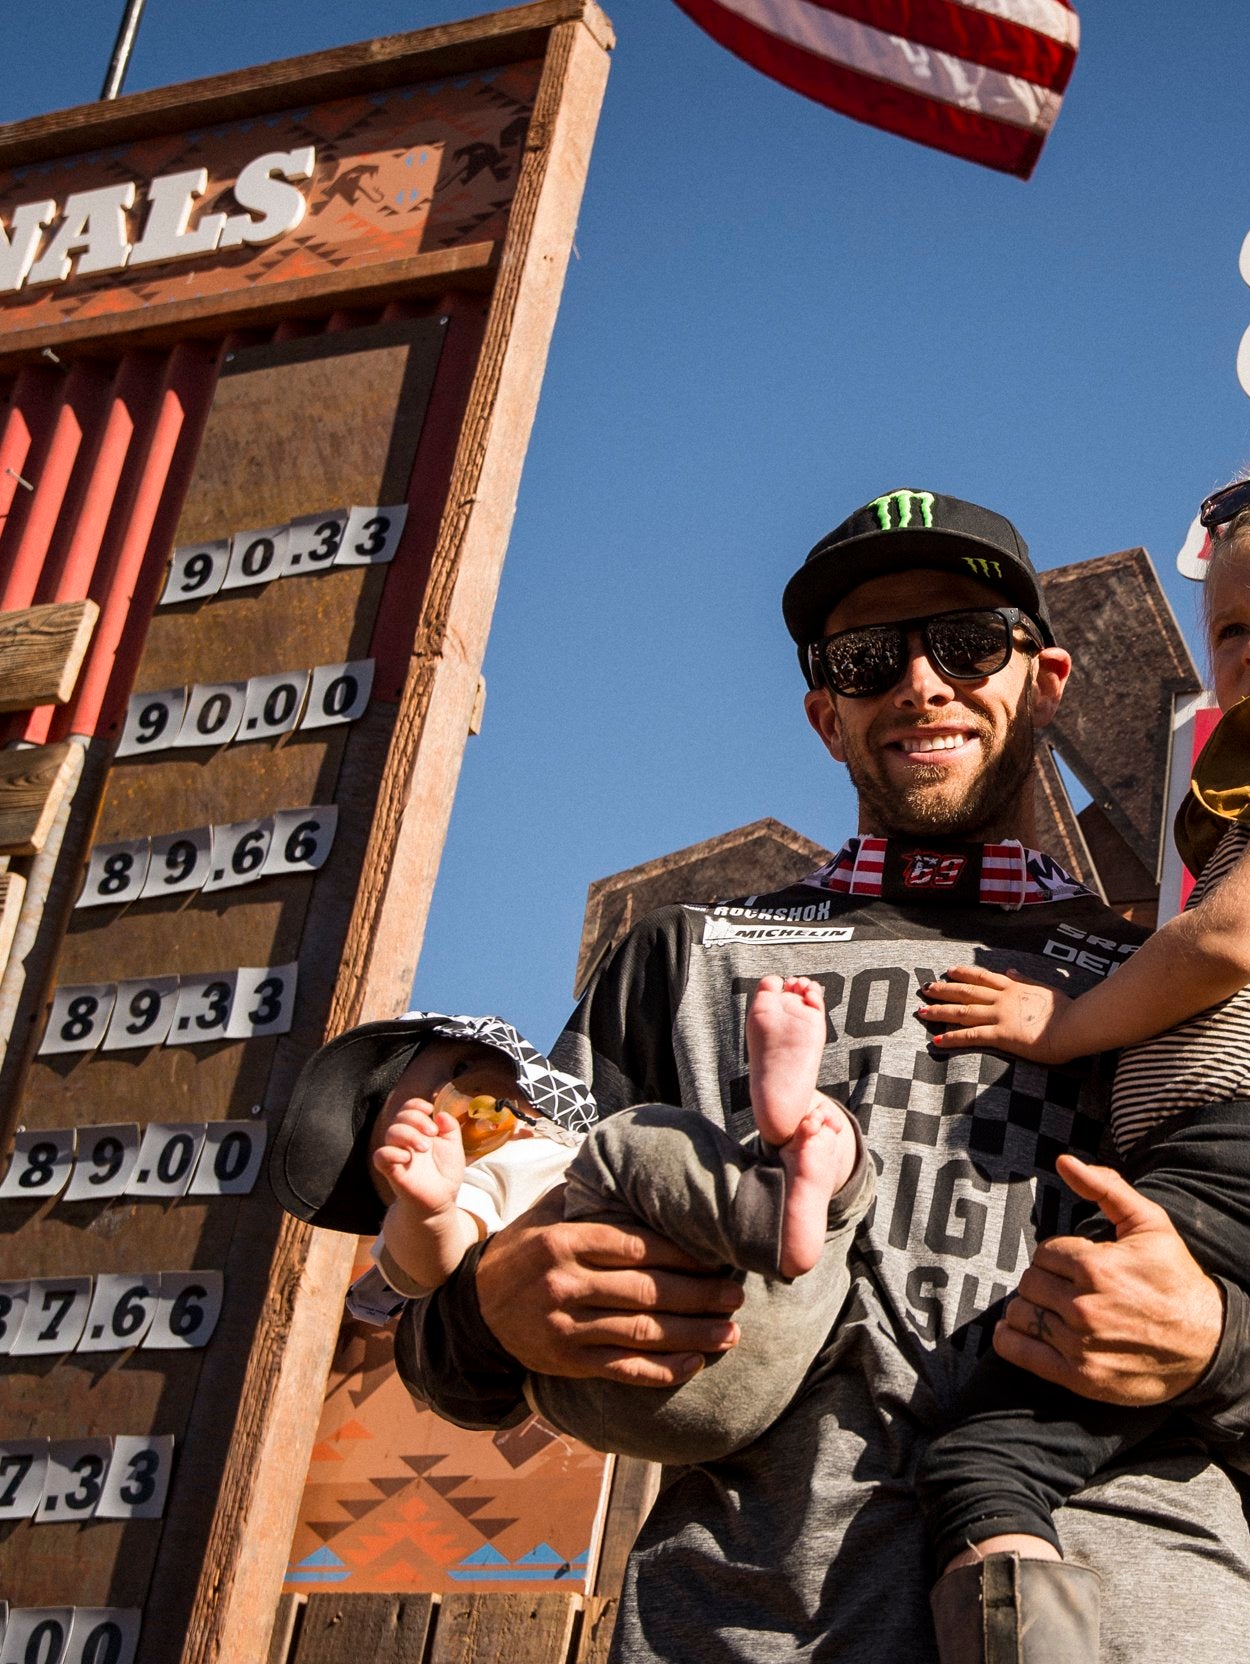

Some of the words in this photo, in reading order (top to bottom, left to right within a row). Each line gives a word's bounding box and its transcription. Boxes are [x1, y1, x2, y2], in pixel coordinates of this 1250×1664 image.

[180, 517, 391, 592] 90.33
[136, 675, 358, 745] 90.00
[97, 820, 320, 896] 89.66
[714, 900, 831, 922] ROCKSHOX
[734, 929, 848, 939] MICHELIN
[60, 977, 285, 1042] 89.33
[18, 1131, 252, 1188] 89.00
